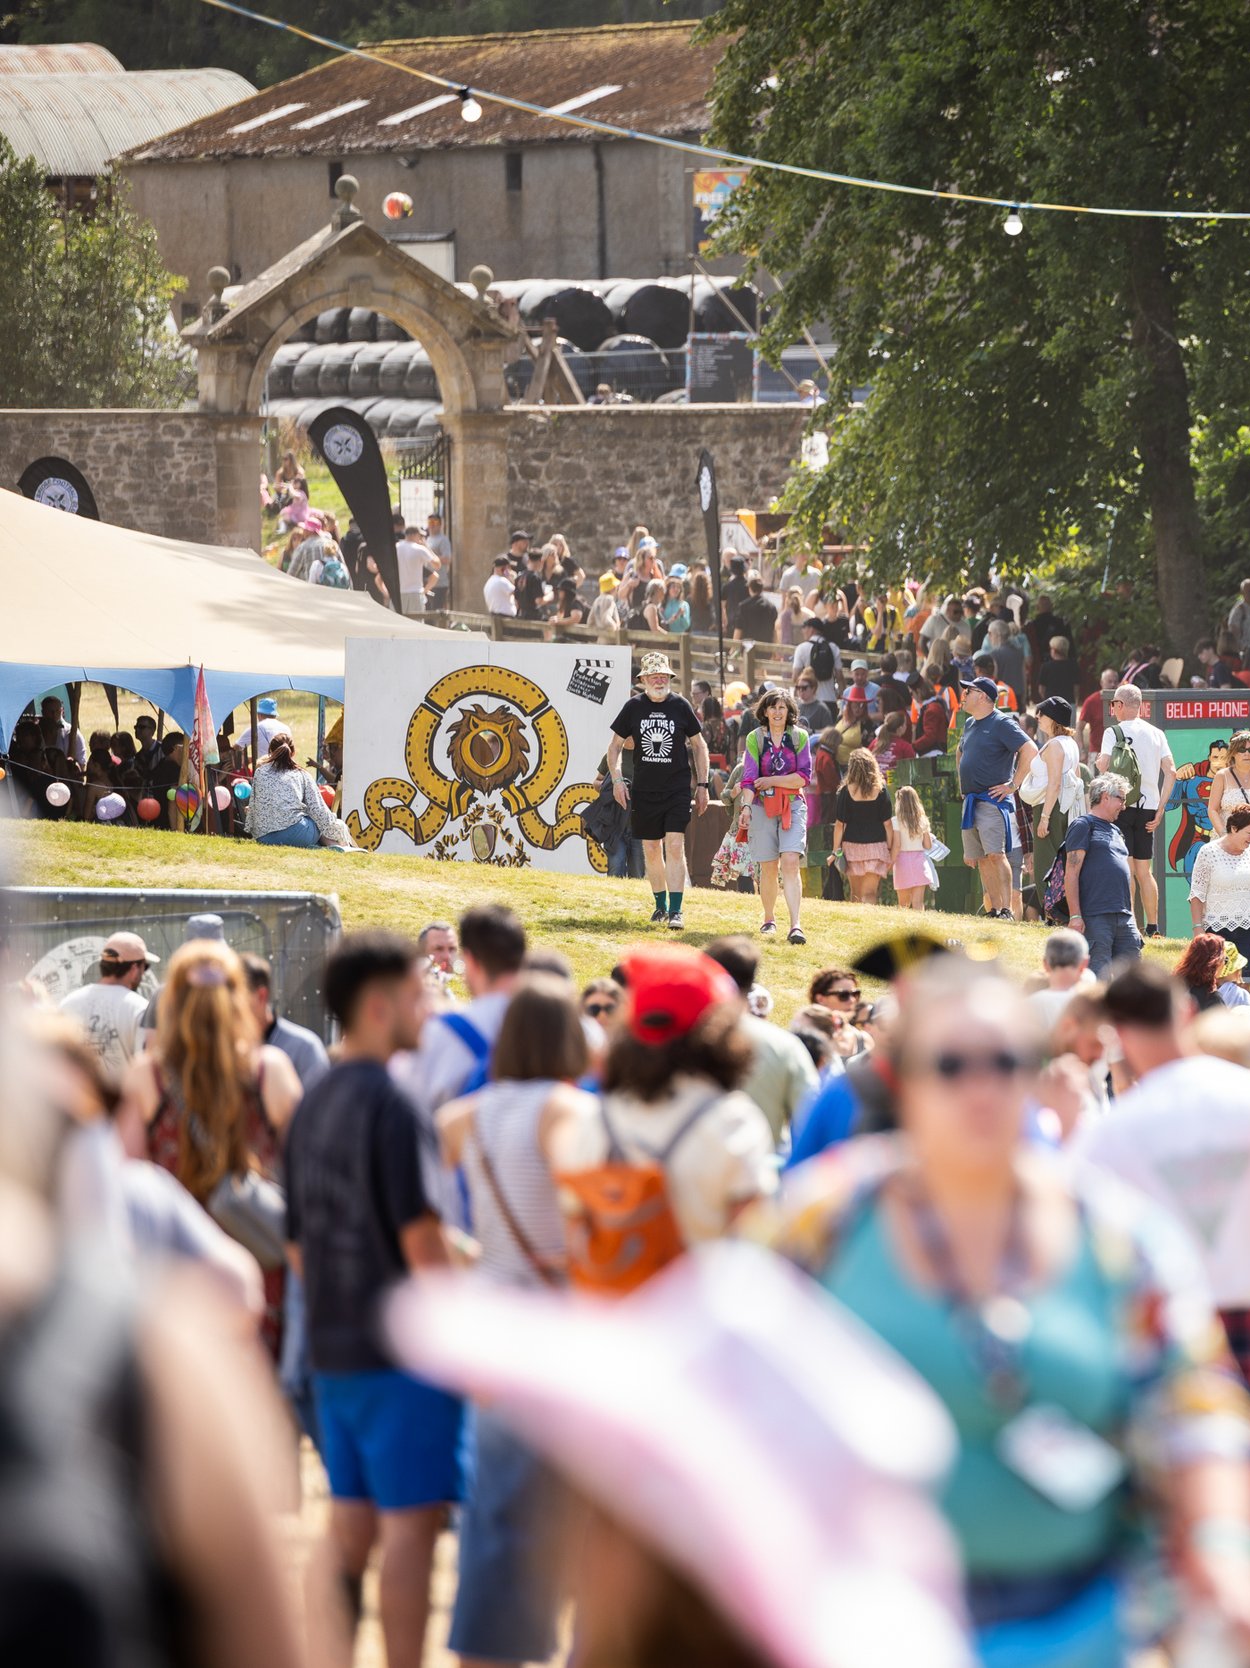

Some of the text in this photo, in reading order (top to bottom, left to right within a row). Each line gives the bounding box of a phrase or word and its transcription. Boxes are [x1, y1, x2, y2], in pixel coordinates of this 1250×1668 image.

[1166, 702, 1249, 719] BELLA PHONE
[640, 719, 675, 735] SPLIT THE G
